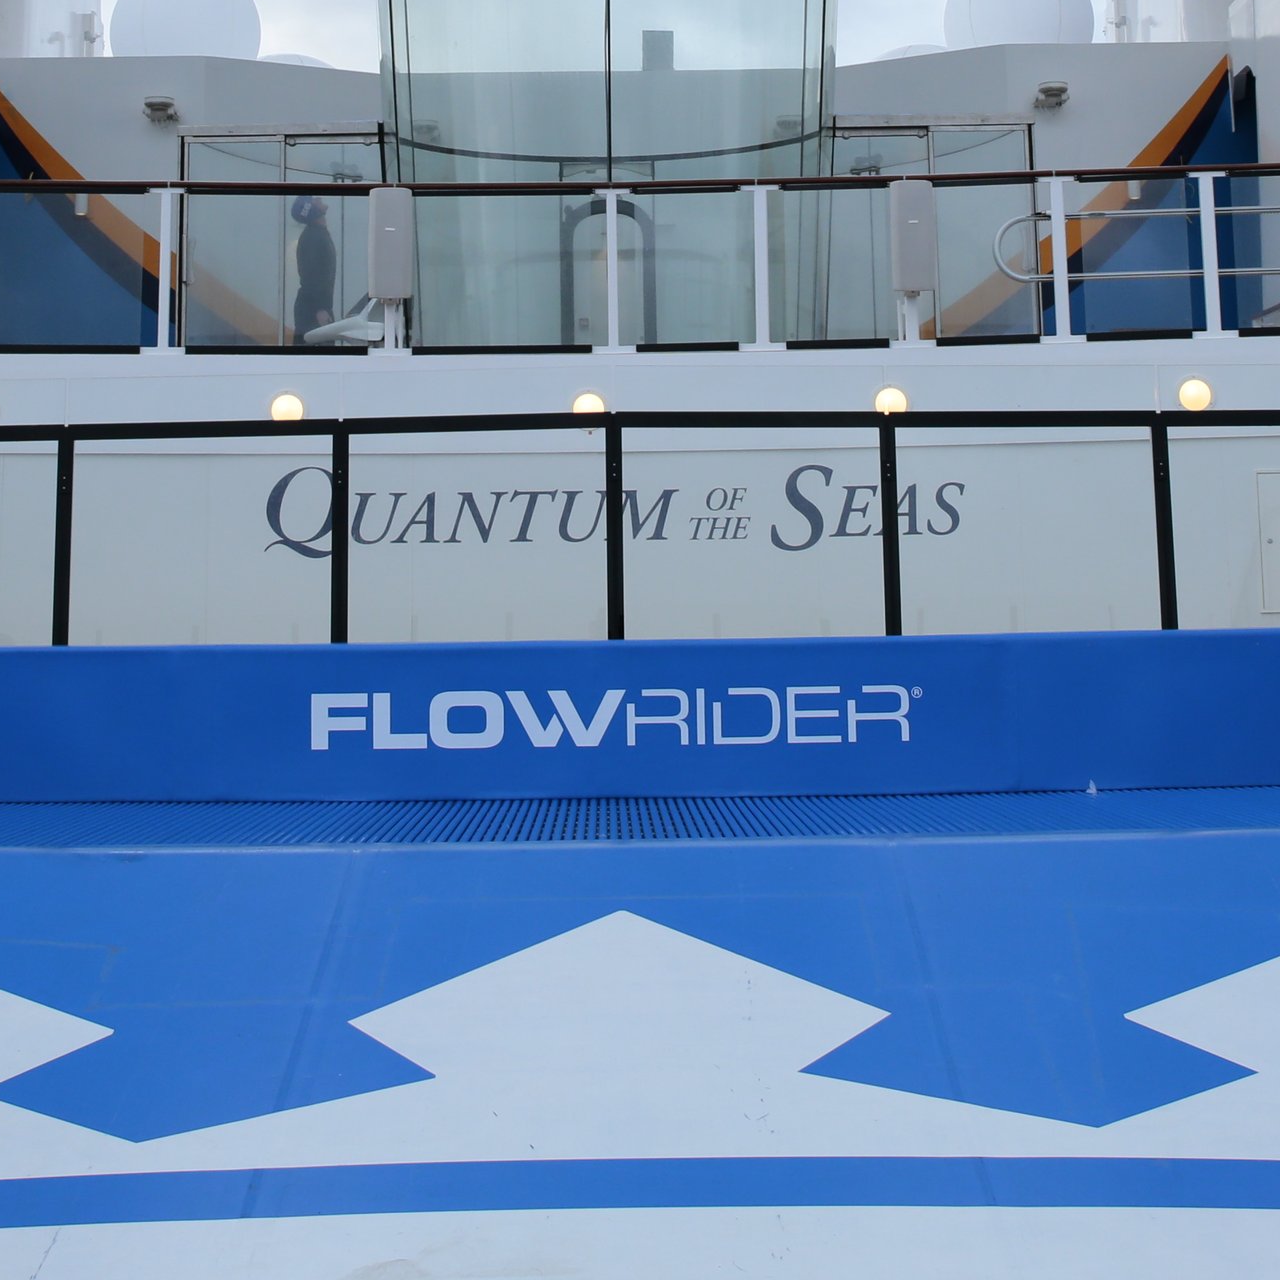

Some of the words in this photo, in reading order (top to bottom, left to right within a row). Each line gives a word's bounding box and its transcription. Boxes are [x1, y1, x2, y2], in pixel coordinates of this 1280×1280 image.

[263, 466, 680, 559] QUANTUM
[705, 487, 748, 512] OF
[770, 464, 966, 552] SEAS
[689, 516, 751, 541] THE
